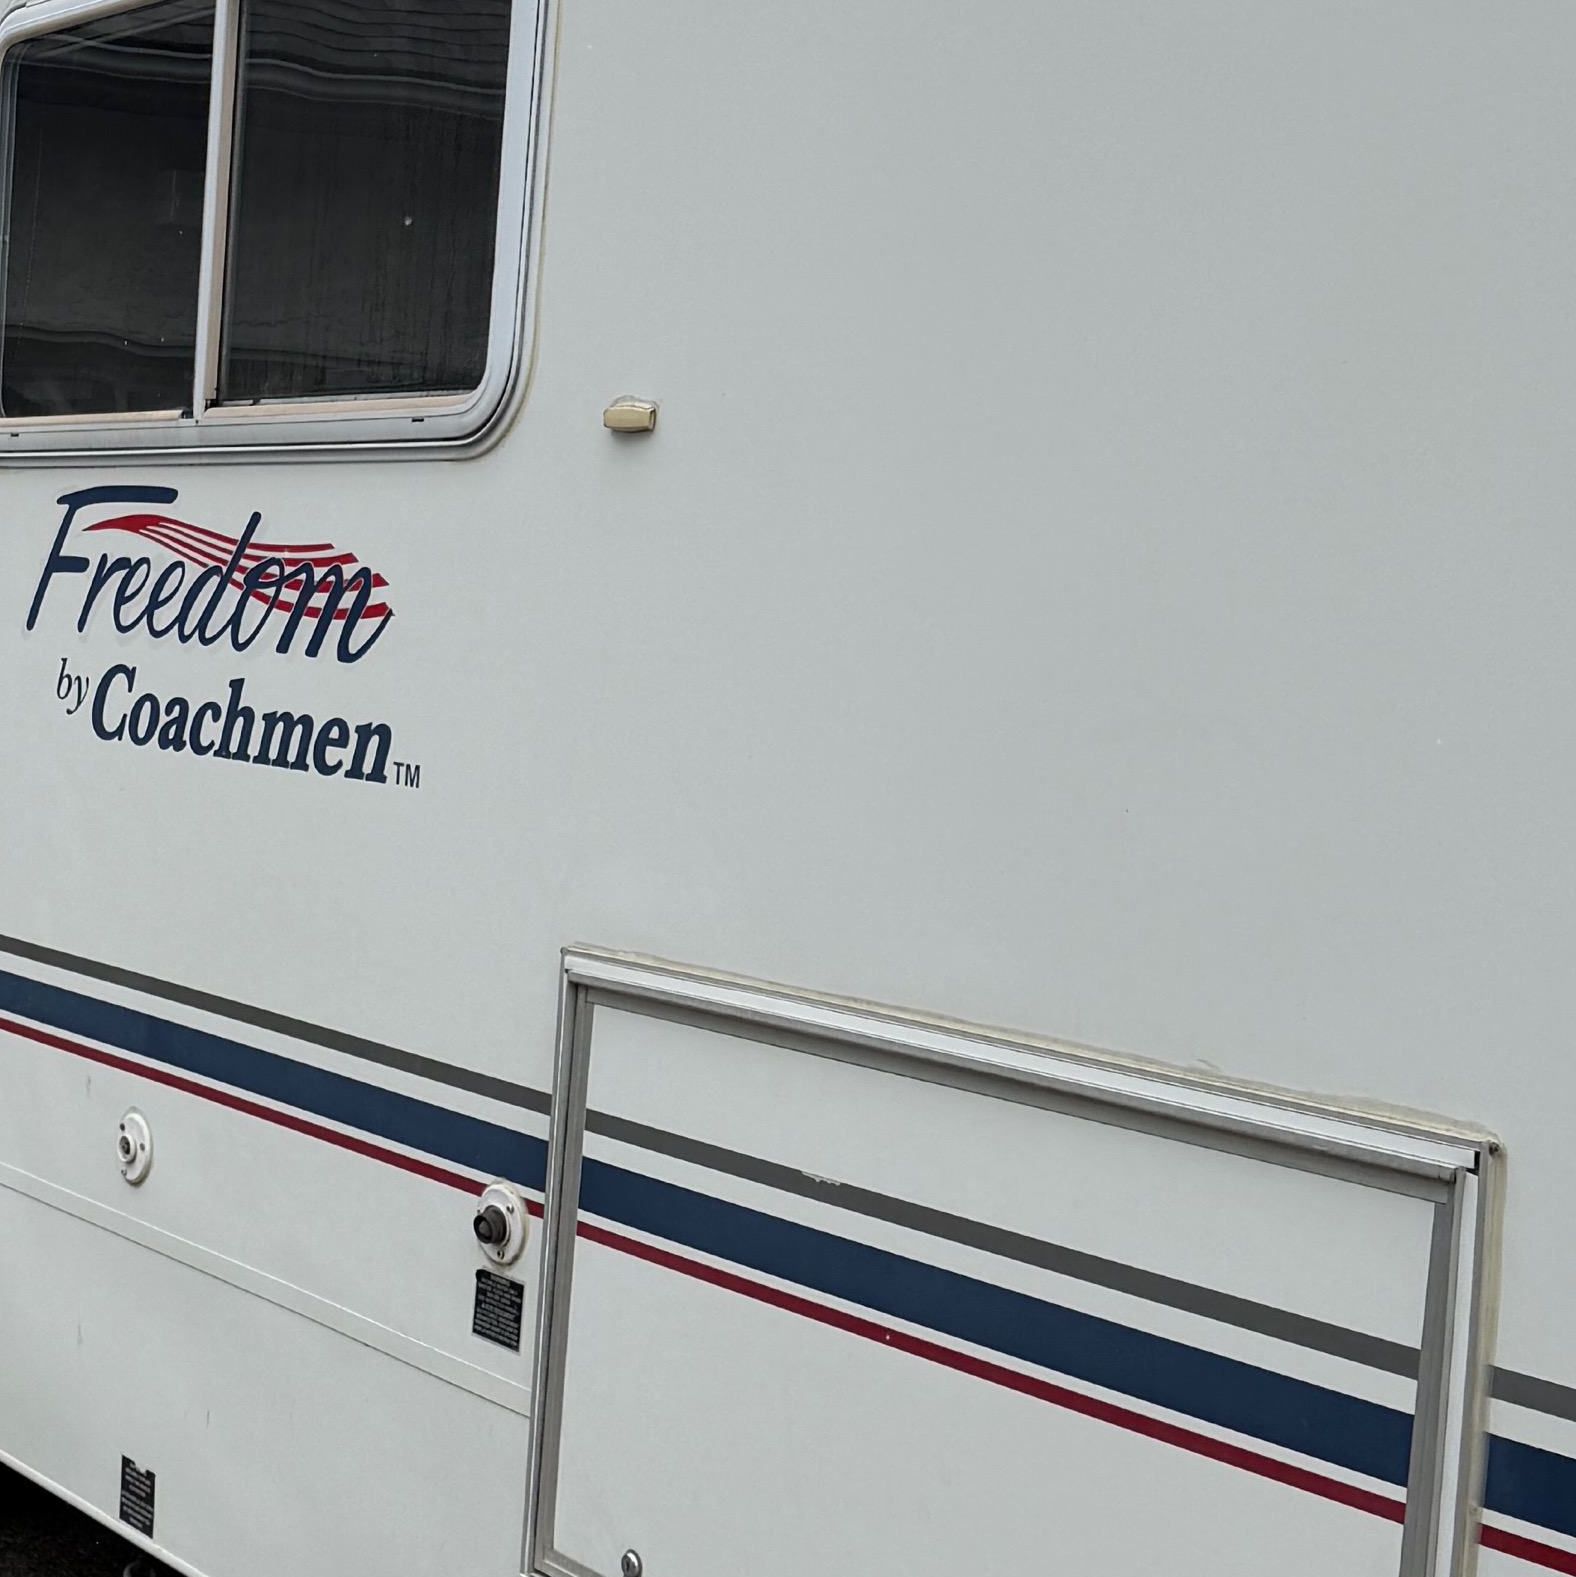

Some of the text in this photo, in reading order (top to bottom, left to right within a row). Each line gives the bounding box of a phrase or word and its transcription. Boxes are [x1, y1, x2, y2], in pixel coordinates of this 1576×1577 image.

[26, 485, 395, 663] Freedom
[56, 657, 90, 715] by
[91, 663, 393, 784] Coachmen
